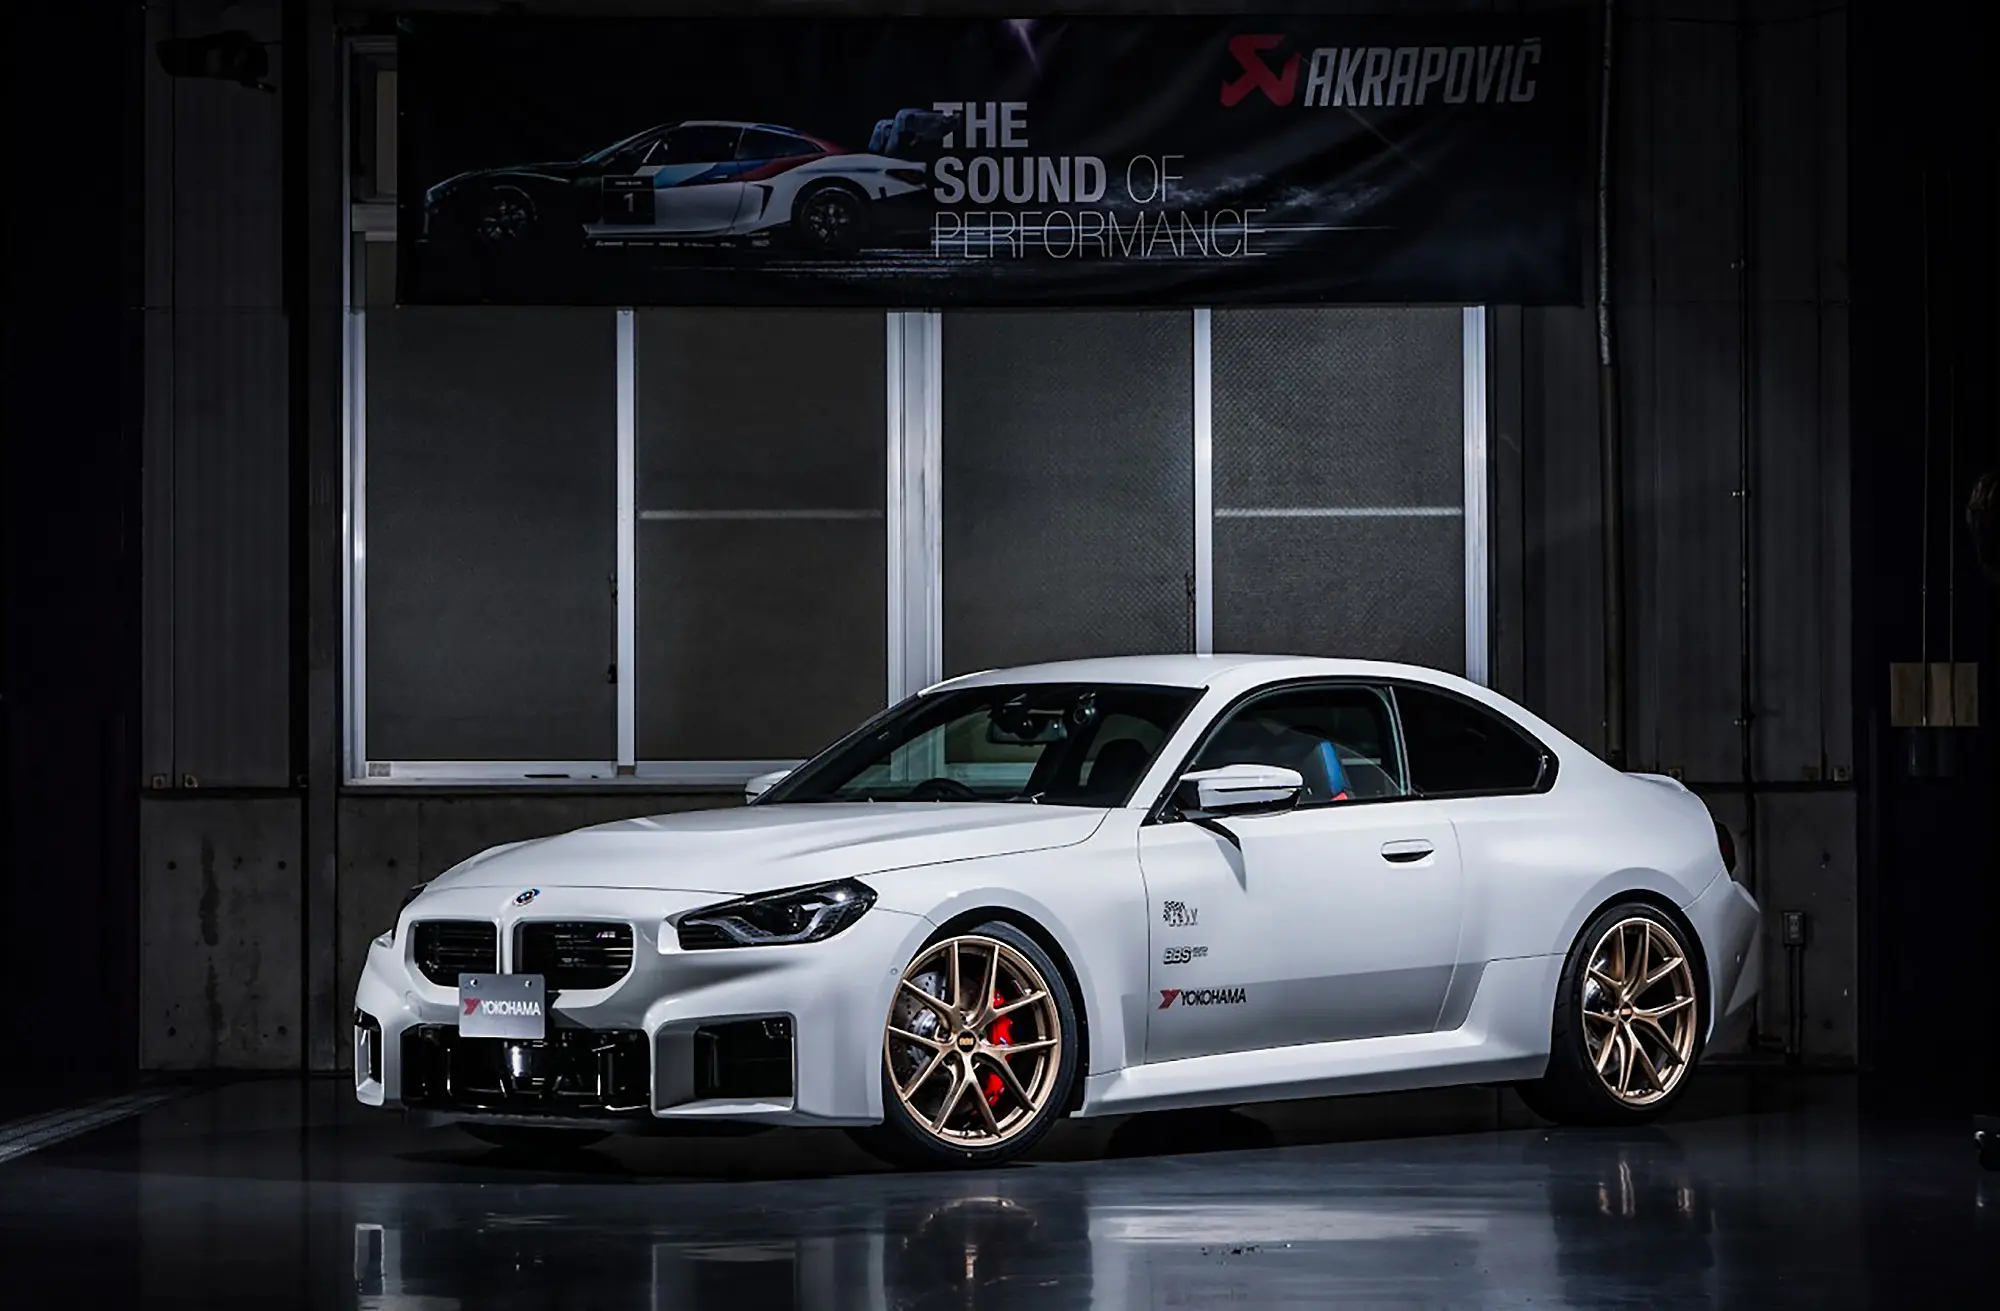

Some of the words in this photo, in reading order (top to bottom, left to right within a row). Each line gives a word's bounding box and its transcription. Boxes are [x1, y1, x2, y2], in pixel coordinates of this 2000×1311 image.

[933, 101, 1029, 149] THE
[933, 155, 1108, 204] SOUND
[1126, 154, 1185, 203] OF
[622, 192, 635, 213] 1
[934, 208, 1267, 259] PERFORMANCE
[1163, 947, 1192, 965] BBS
[1180, 988, 1247, 1006] YOKOHAMA
[480, 1000, 541, 1016] YOKOHAMA
